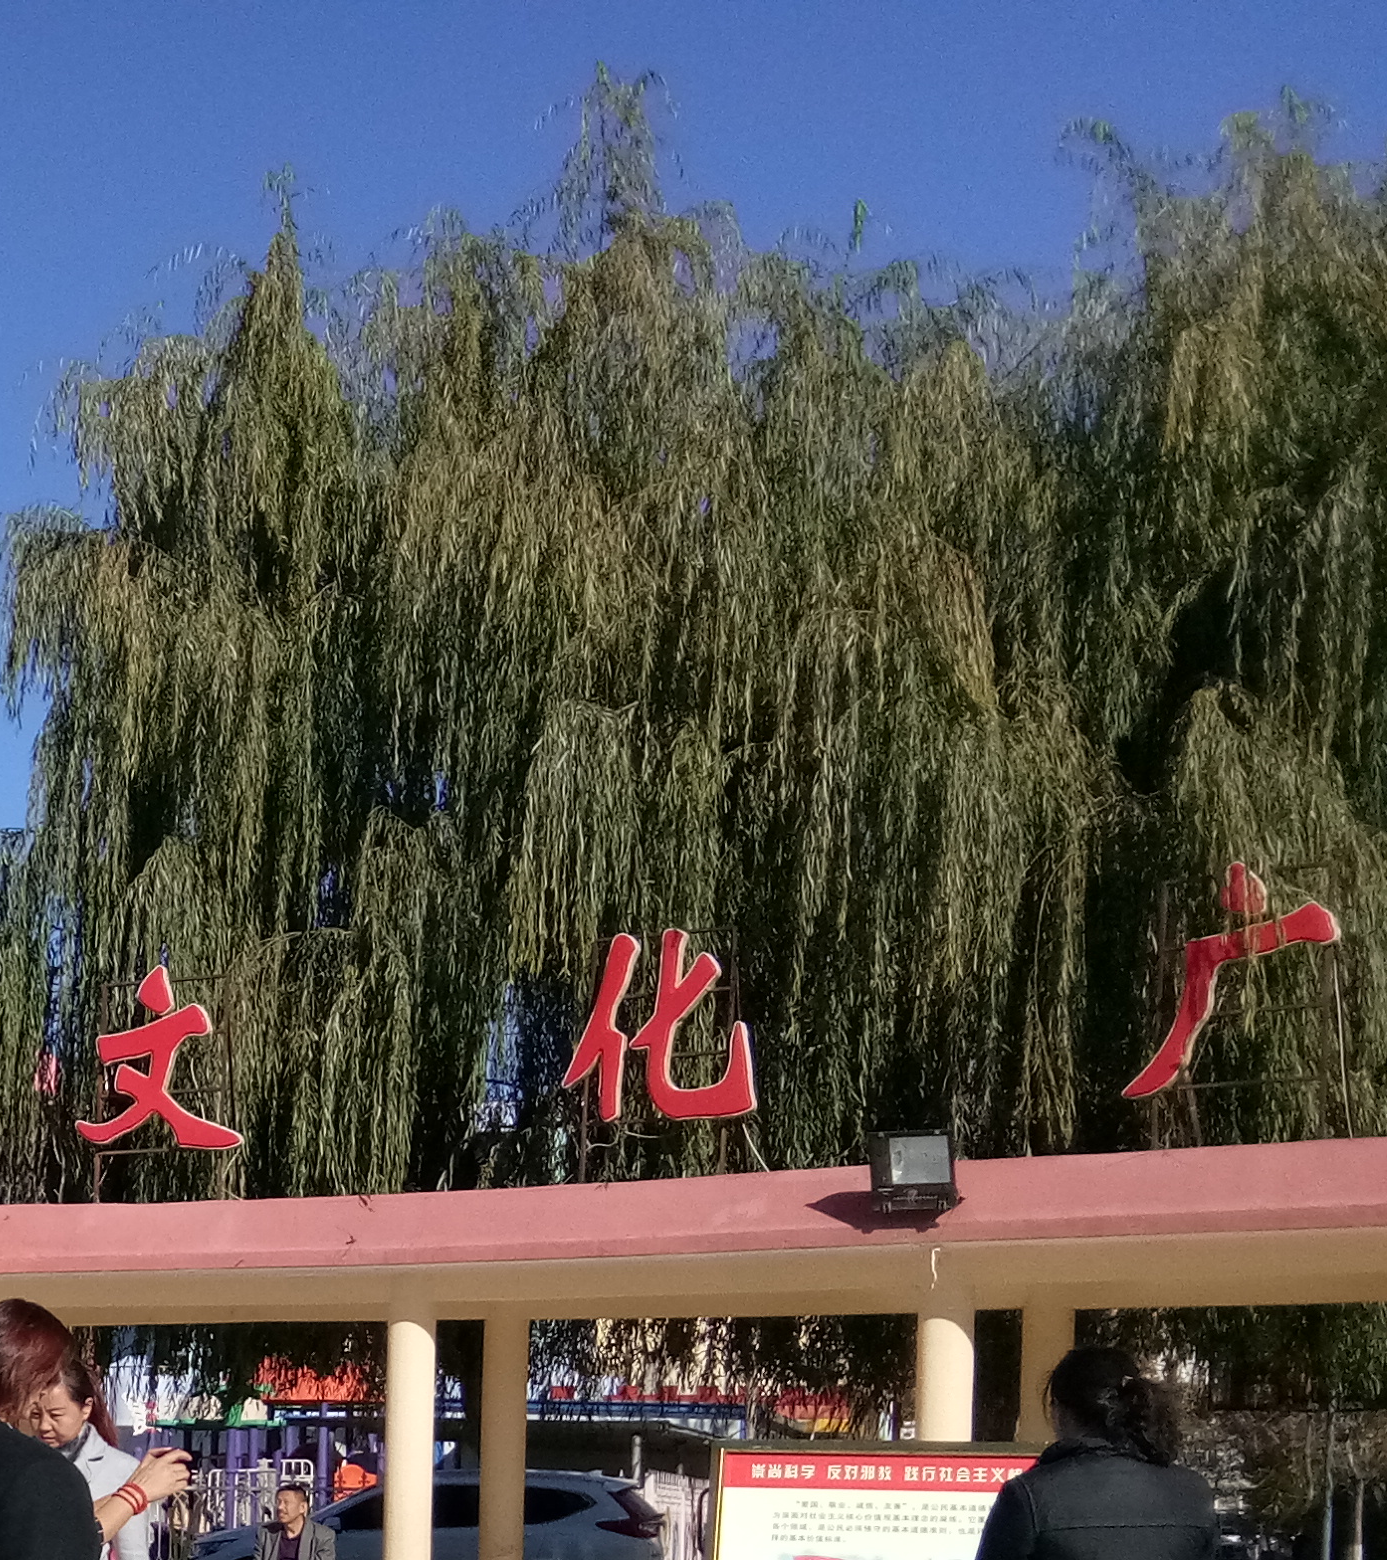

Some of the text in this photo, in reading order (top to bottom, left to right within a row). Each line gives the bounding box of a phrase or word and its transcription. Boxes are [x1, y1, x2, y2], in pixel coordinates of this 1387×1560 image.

[751, 1463, 817, 1479] 崇尚科学
[827, 1464, 893, 1481] 反对邪教
